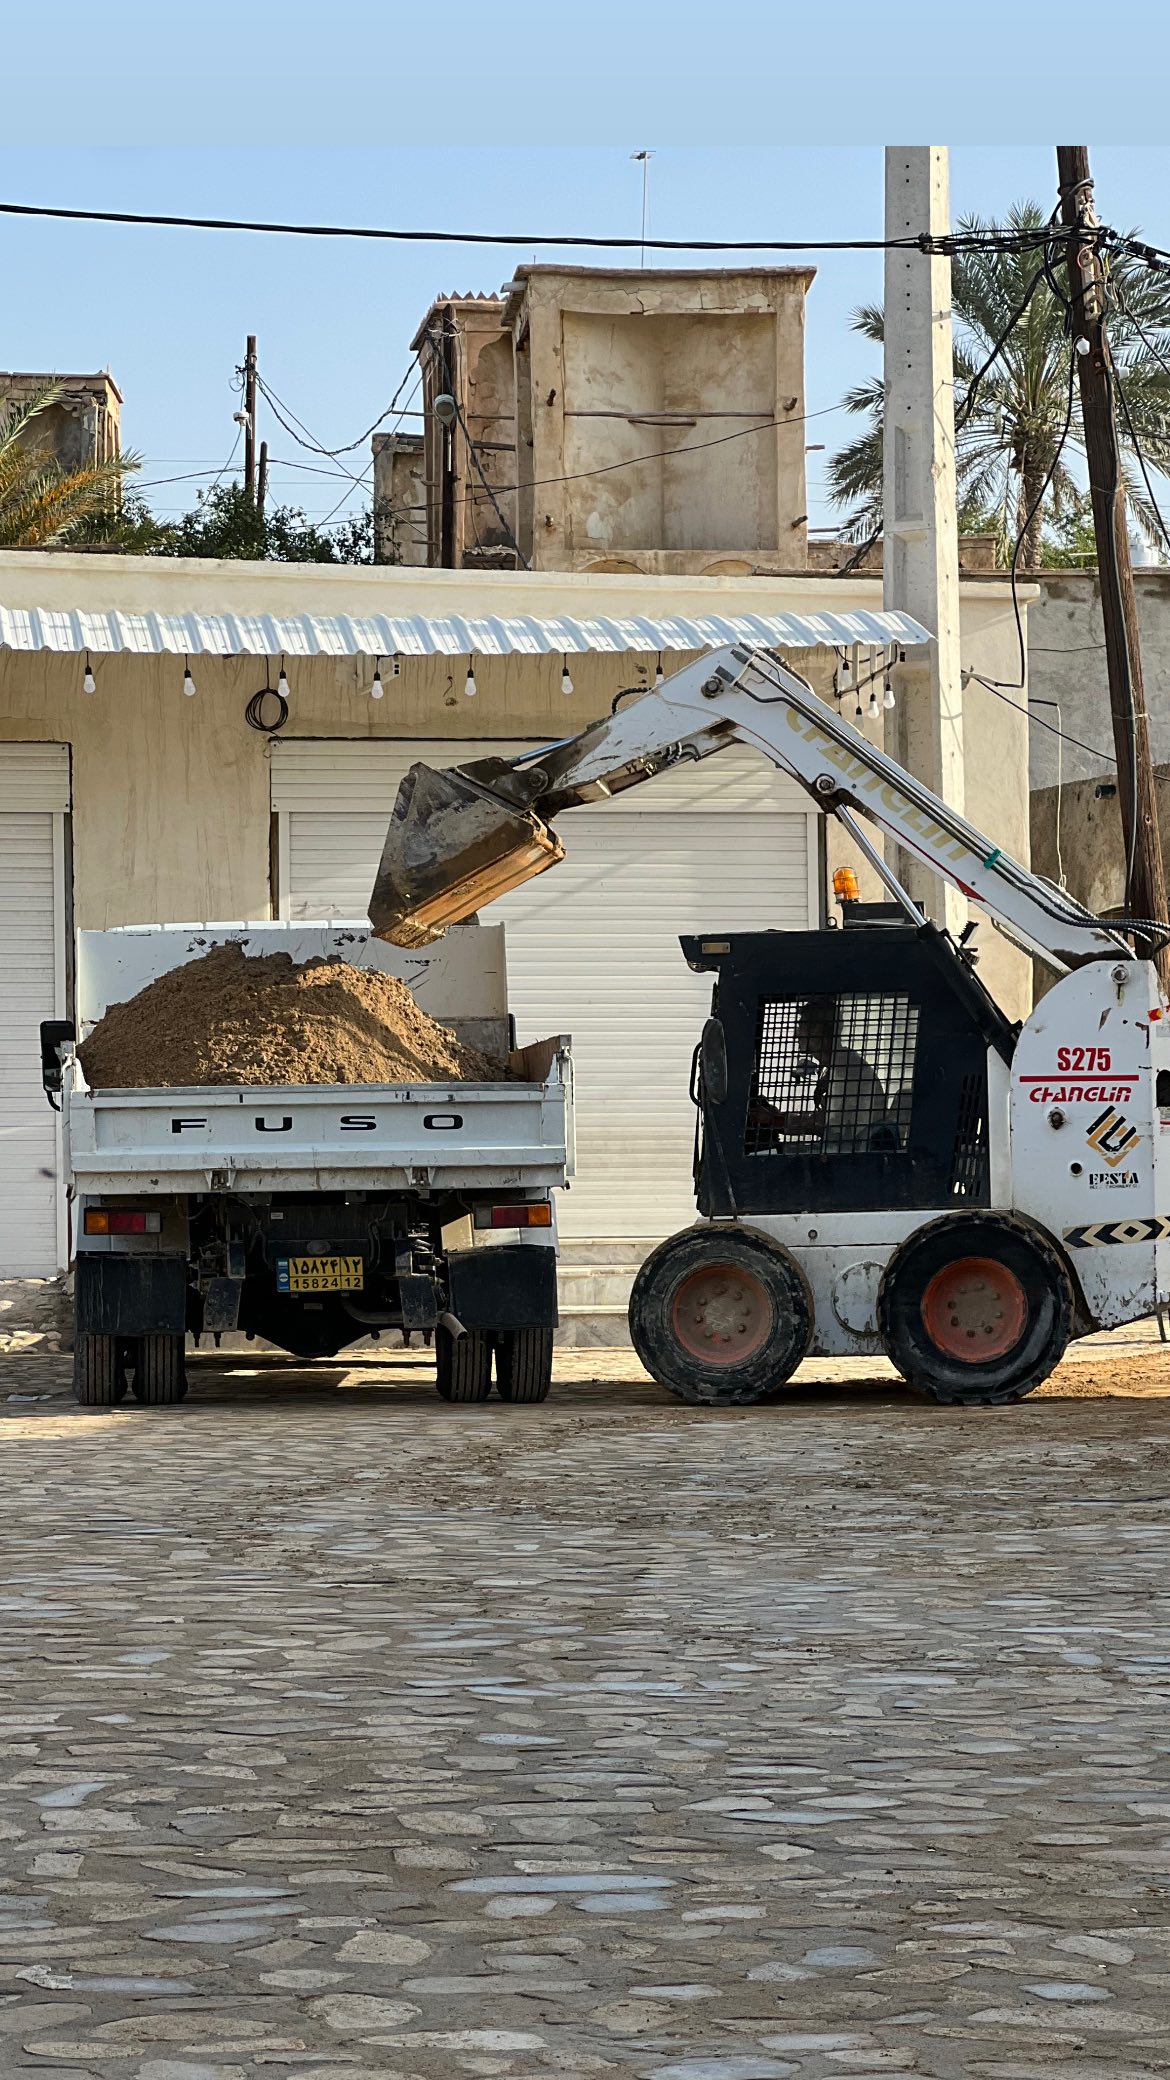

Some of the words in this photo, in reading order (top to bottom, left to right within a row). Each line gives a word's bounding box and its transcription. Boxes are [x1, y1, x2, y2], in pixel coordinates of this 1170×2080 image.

[1057, 1047, 1111, 1072] S275
[171, 1114, 464, 1134] FUSO
[293, 1277, 338, 1289] 15824
[345, 1277, 361, 1288] 12
